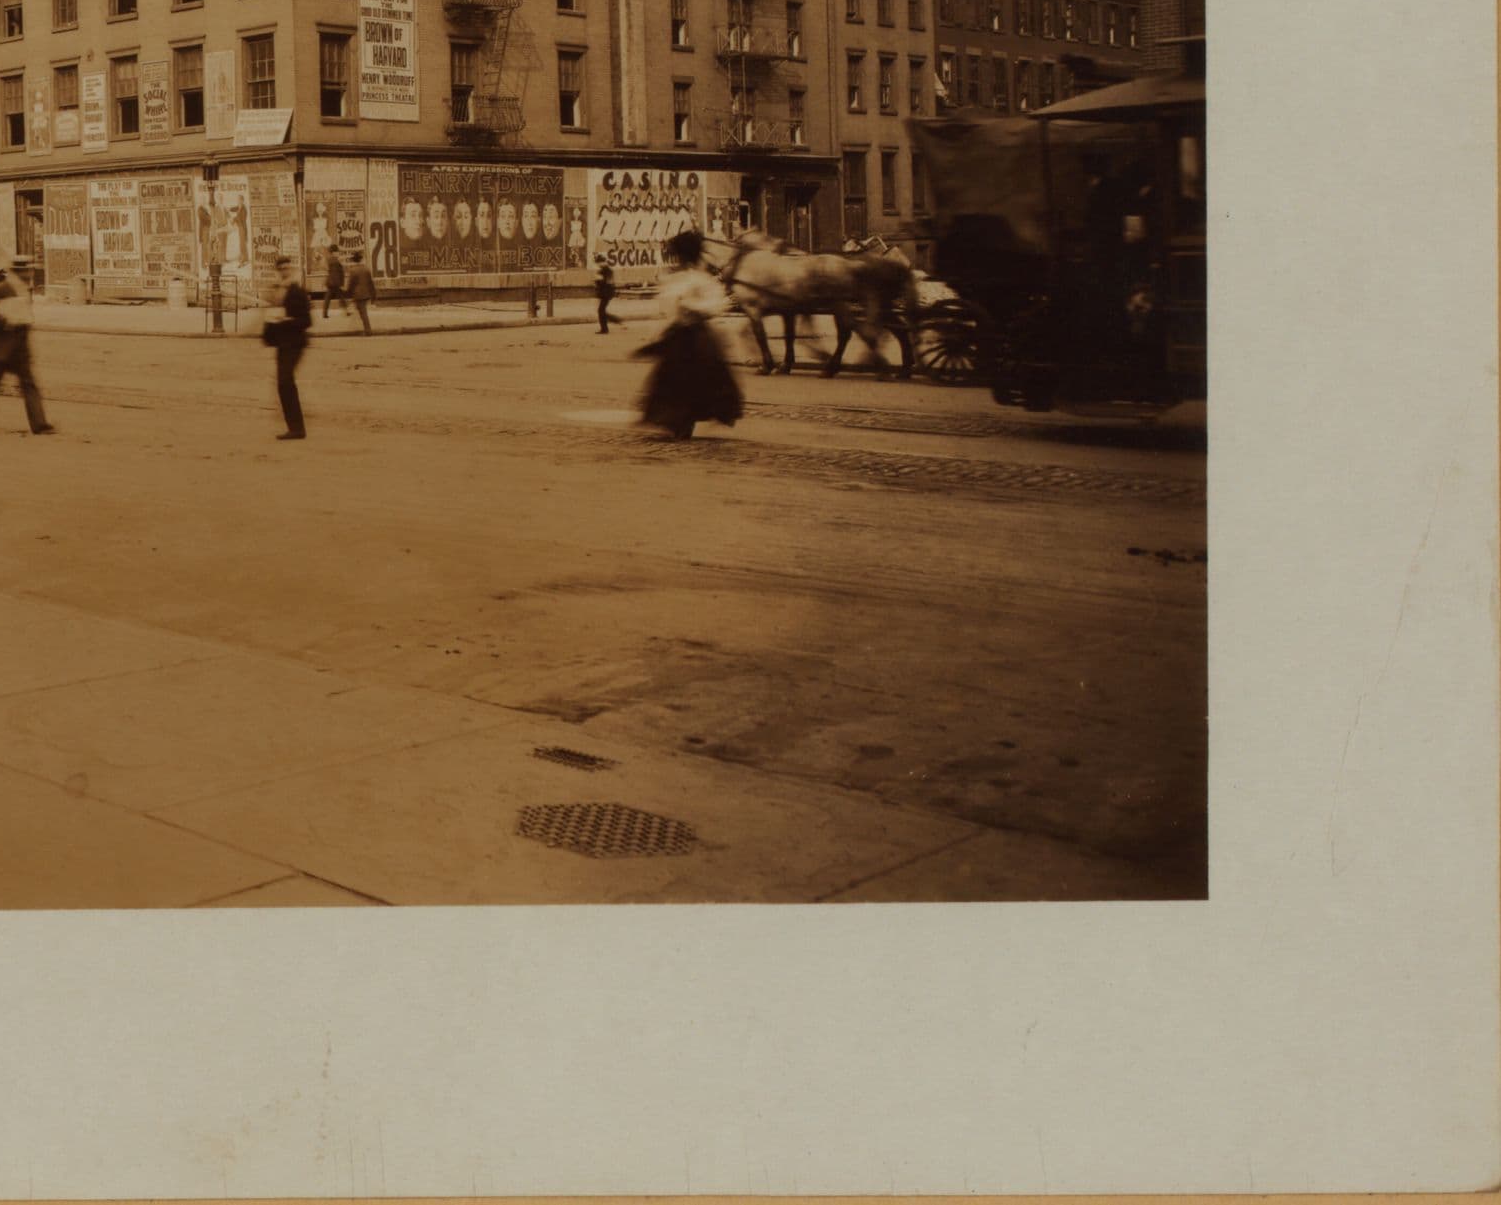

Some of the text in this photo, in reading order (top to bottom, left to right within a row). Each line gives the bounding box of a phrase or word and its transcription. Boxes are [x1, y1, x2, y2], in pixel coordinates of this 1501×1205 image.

[365, 21, 403, 44] BROWN OF
[372, 45, 407, 68] HARVARD
[143, 89, 167, 104] SOCIAL
[462, 166, 520, 174] EXPRESSIONS
[401, 171, 474, 193] HENRY
[497, 175, 562, 194] DIXEY
[602, 171, 699, 191] CASINO
[49, 206, 85, 235] DIXEY
[337, 219, 363, 234] SOCIAL
[252, 235, 281, 249] SOCIAL
[369, 220, 399, 279] 28
[430, 245, 481, 268] MAN
[518, 245, 564, 266] BOX
[607, 248, 656, 266] SOCIAL
